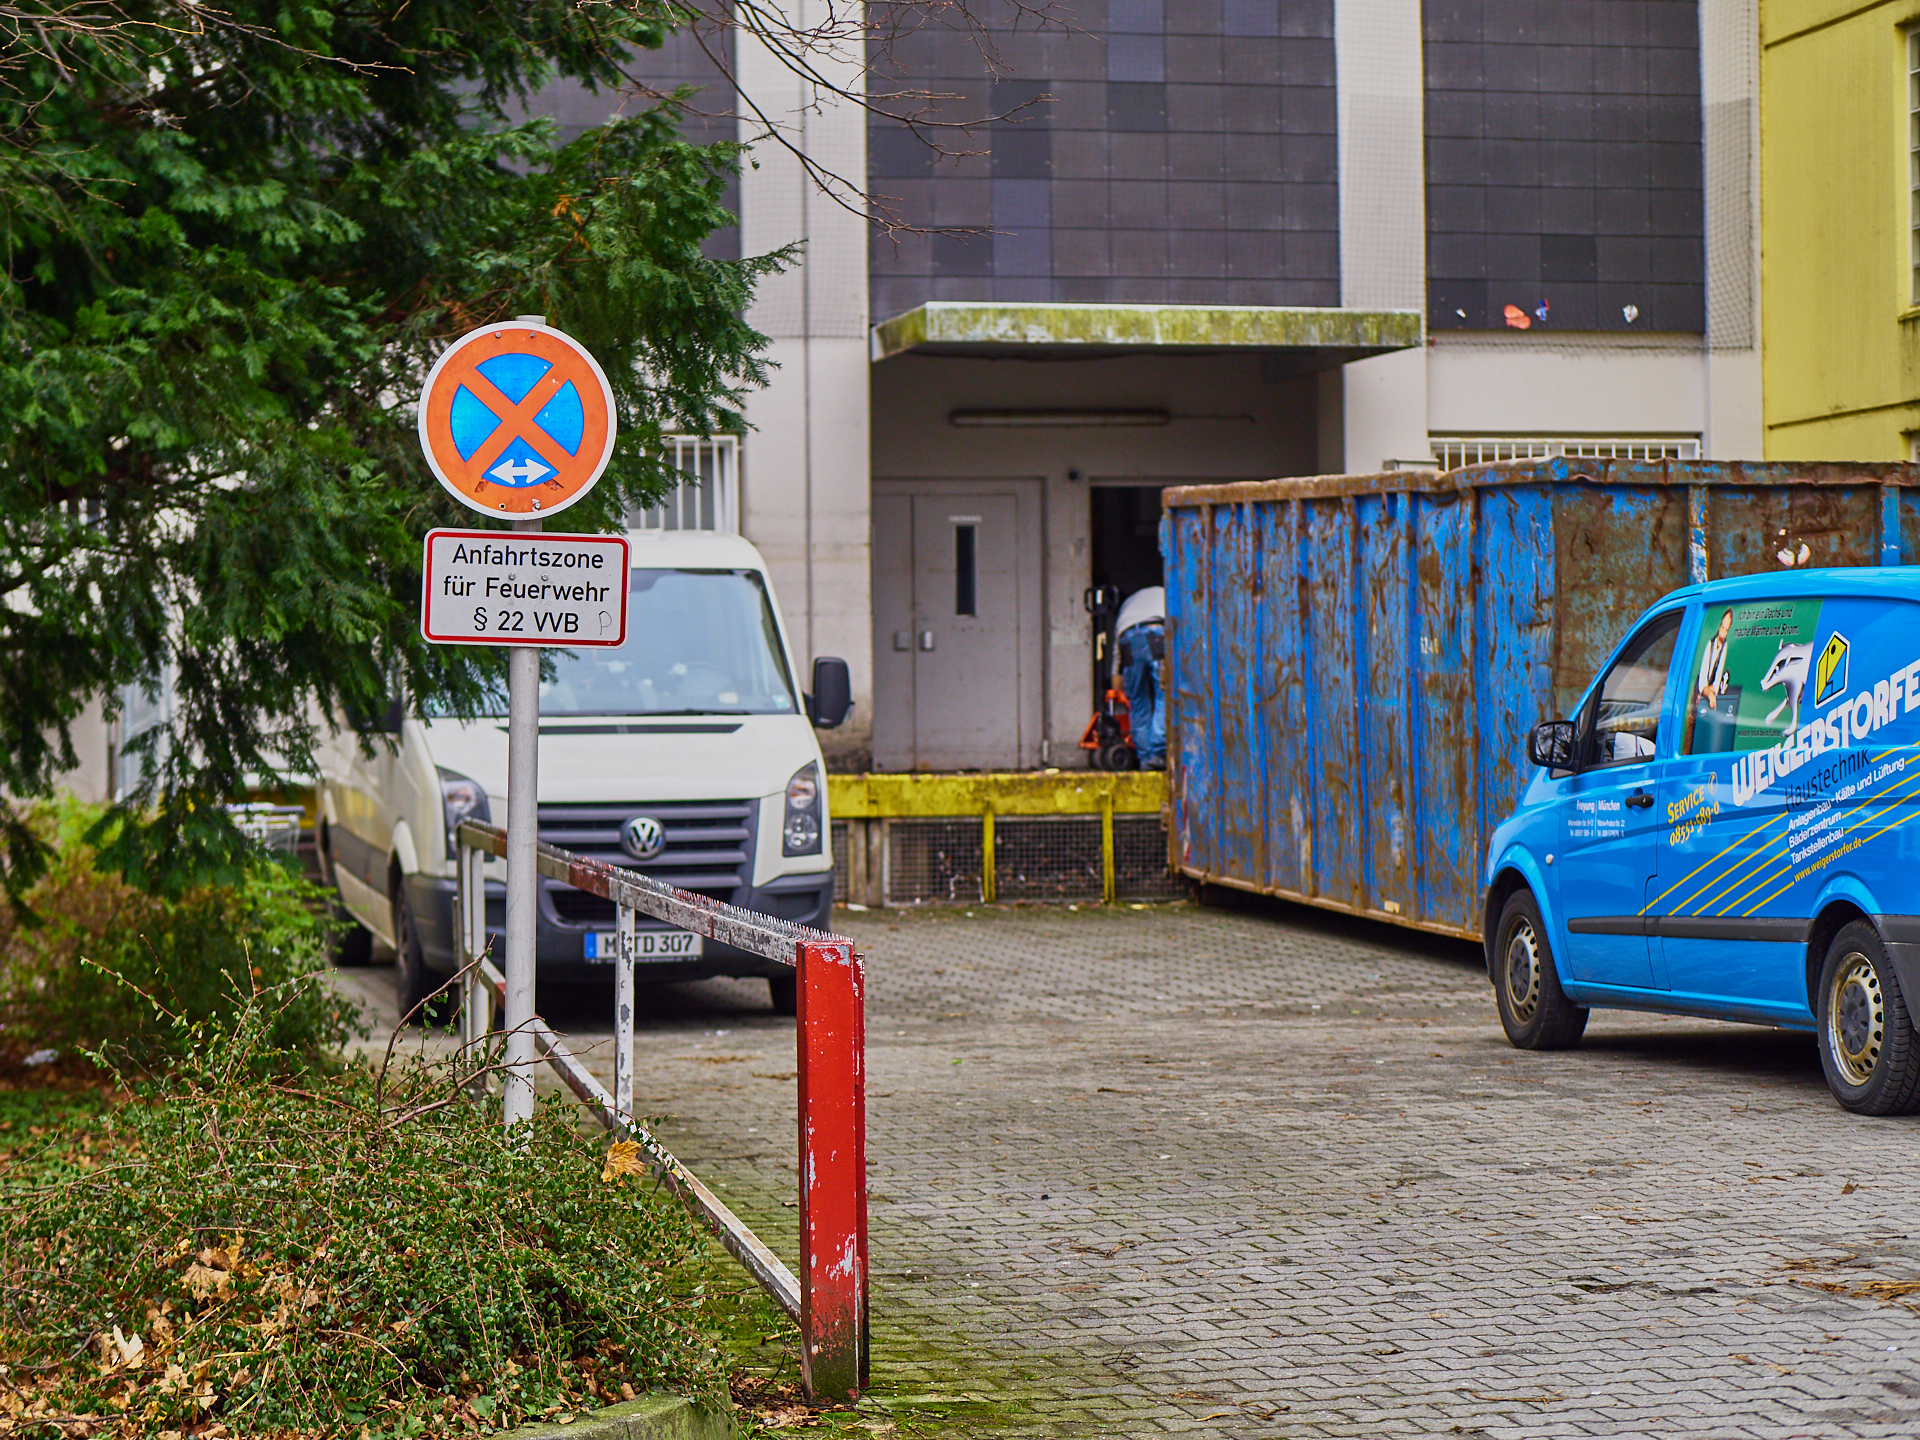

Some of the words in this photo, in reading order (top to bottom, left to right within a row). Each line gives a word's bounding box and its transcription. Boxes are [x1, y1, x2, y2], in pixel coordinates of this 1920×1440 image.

[452, 543, 604, 569] Anfahrtszone
[443, 575, 476, 597] für
[485, 576, 610, 602] Feuerwehr
[473, 606, 488, 632] §
[497, 610, 524, 632] 22
[533, 611, 580, 634] VVB
[1733, 625, 1751, 638] mache
[1750, 624, 1770, 637] Wärme
[1769, 623, 1782, 636] und
[1746, 608, 1756, 620] bin
[1755, 608, 1765, 620] ein
[1764, 607, 1782, 619] Dachs
[1781, 605, 1794, 618] und
[1732, 658, 1920, 807] WEIGERSTORFE
[1784, 747, 1871, 813] Haustechnik
[1788, 799, 1832, 831] Anlagenbau
[1835, 784, 1856, 803] Kälte
[1856, 771, 1873, 791] und
[1873, 757, 1905, 782] Lüftung
[1597, 799, 1620, 811] München
[1667, 785, 1705, 825] SERVICE
[1669, 800, 1720, 847] 08551-589-0
[1788, 811, 1842, 849] Bäderzentrum
[1790, 827, 1845, 865] Tankstellenbau
[1793, 837, 1863, 883] www.weigerstorfer.de
[659, 933, 694, 954] 307
